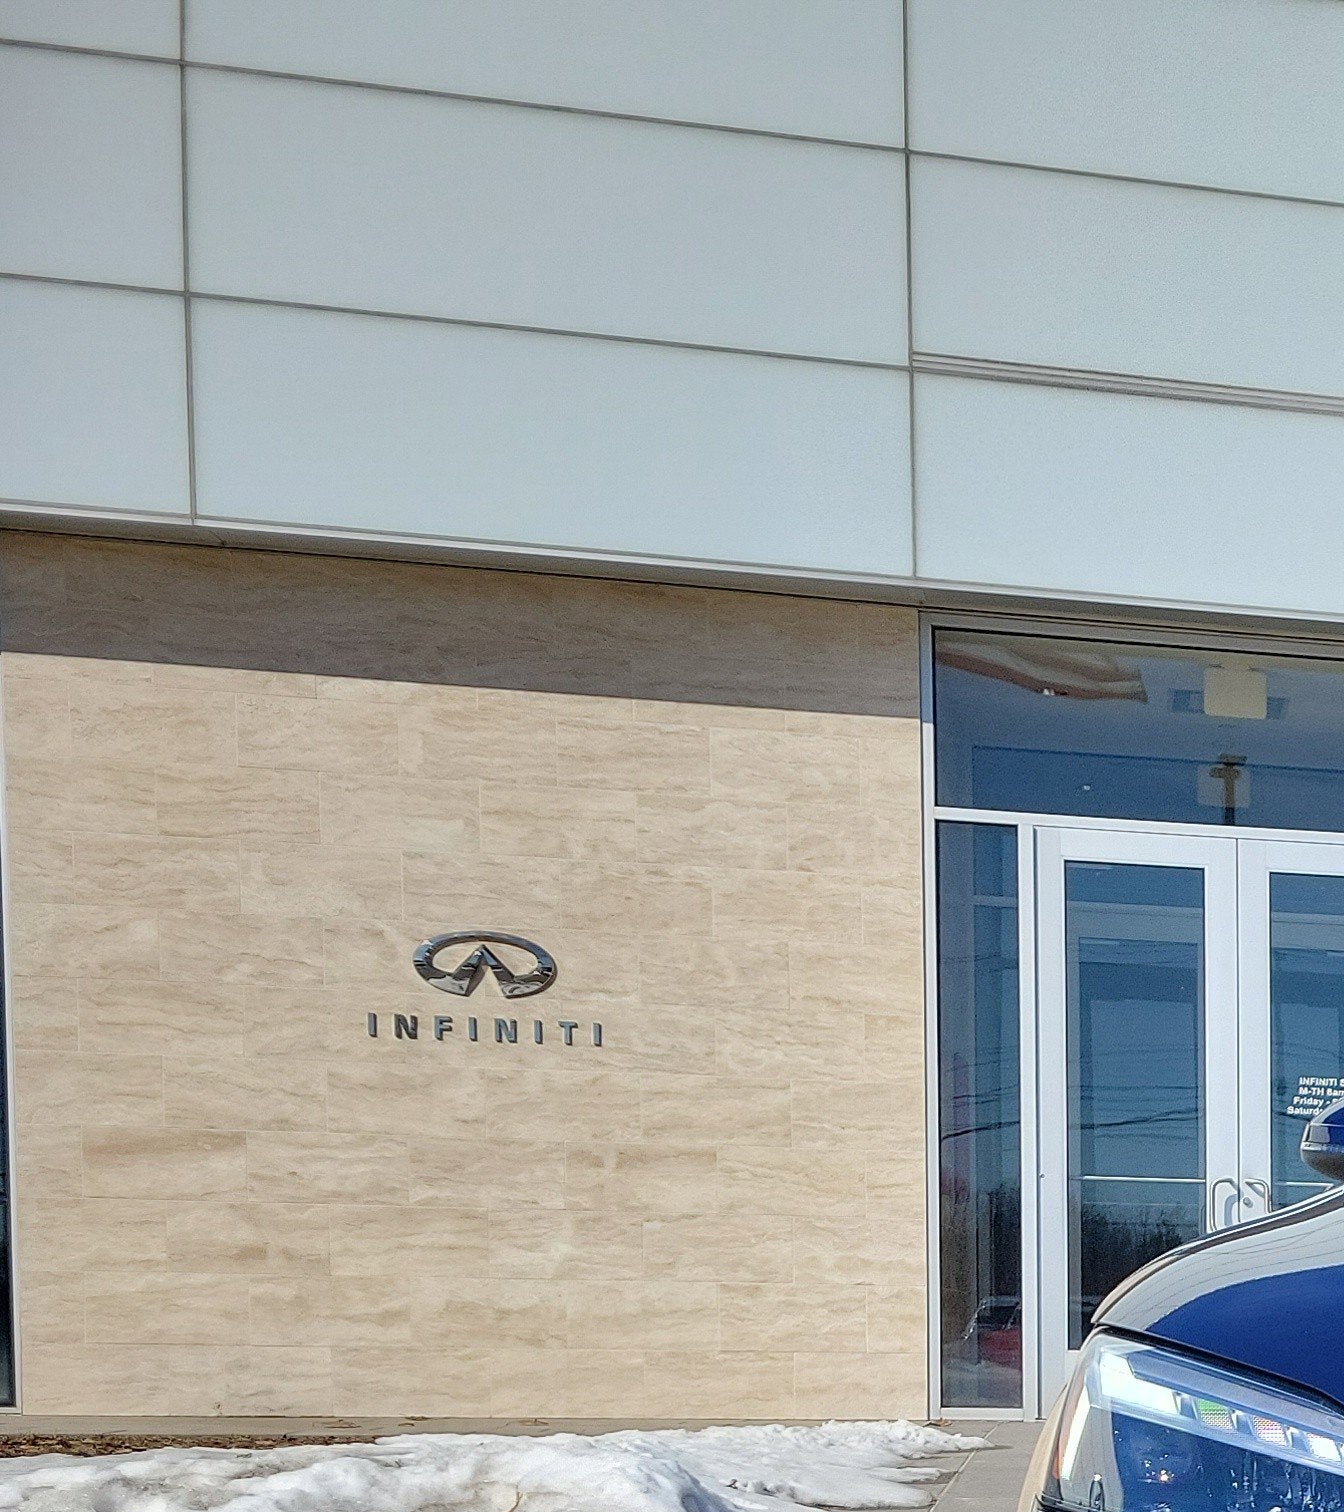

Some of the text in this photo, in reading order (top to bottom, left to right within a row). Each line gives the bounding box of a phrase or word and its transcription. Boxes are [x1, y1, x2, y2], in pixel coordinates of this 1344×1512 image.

[367, 1012, 602, 1047] INFINITI
[1299, 1077, 1338, 1087] INFINITI
[1293, 1096, 1324, 1108] Friday
[1286, 1106, 1323, 1116] Saturd
